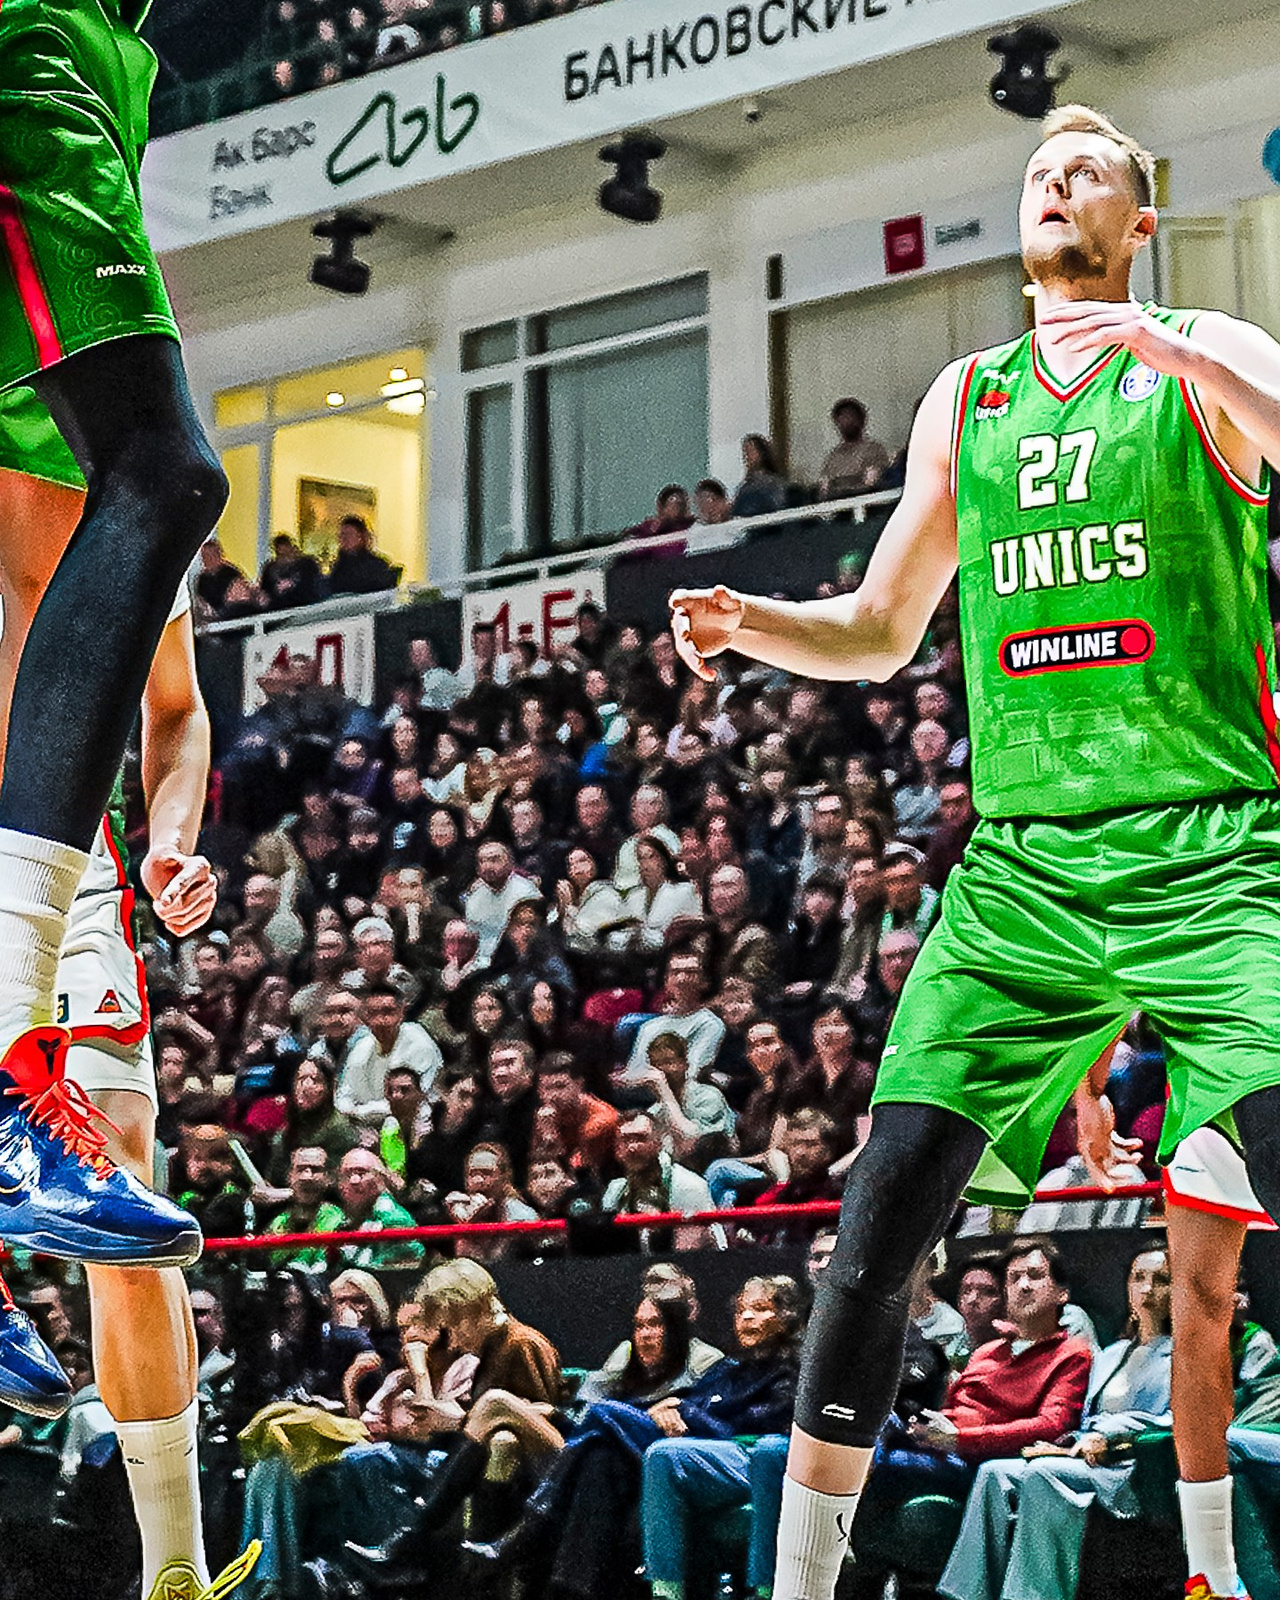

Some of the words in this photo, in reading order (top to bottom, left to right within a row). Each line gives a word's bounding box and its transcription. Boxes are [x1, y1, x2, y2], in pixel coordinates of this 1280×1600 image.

[1017, 427, 1098, 511] 27
[990, 520, 1148, 597] UNICS
[1011, 631, 1117, 669] WINLINE
